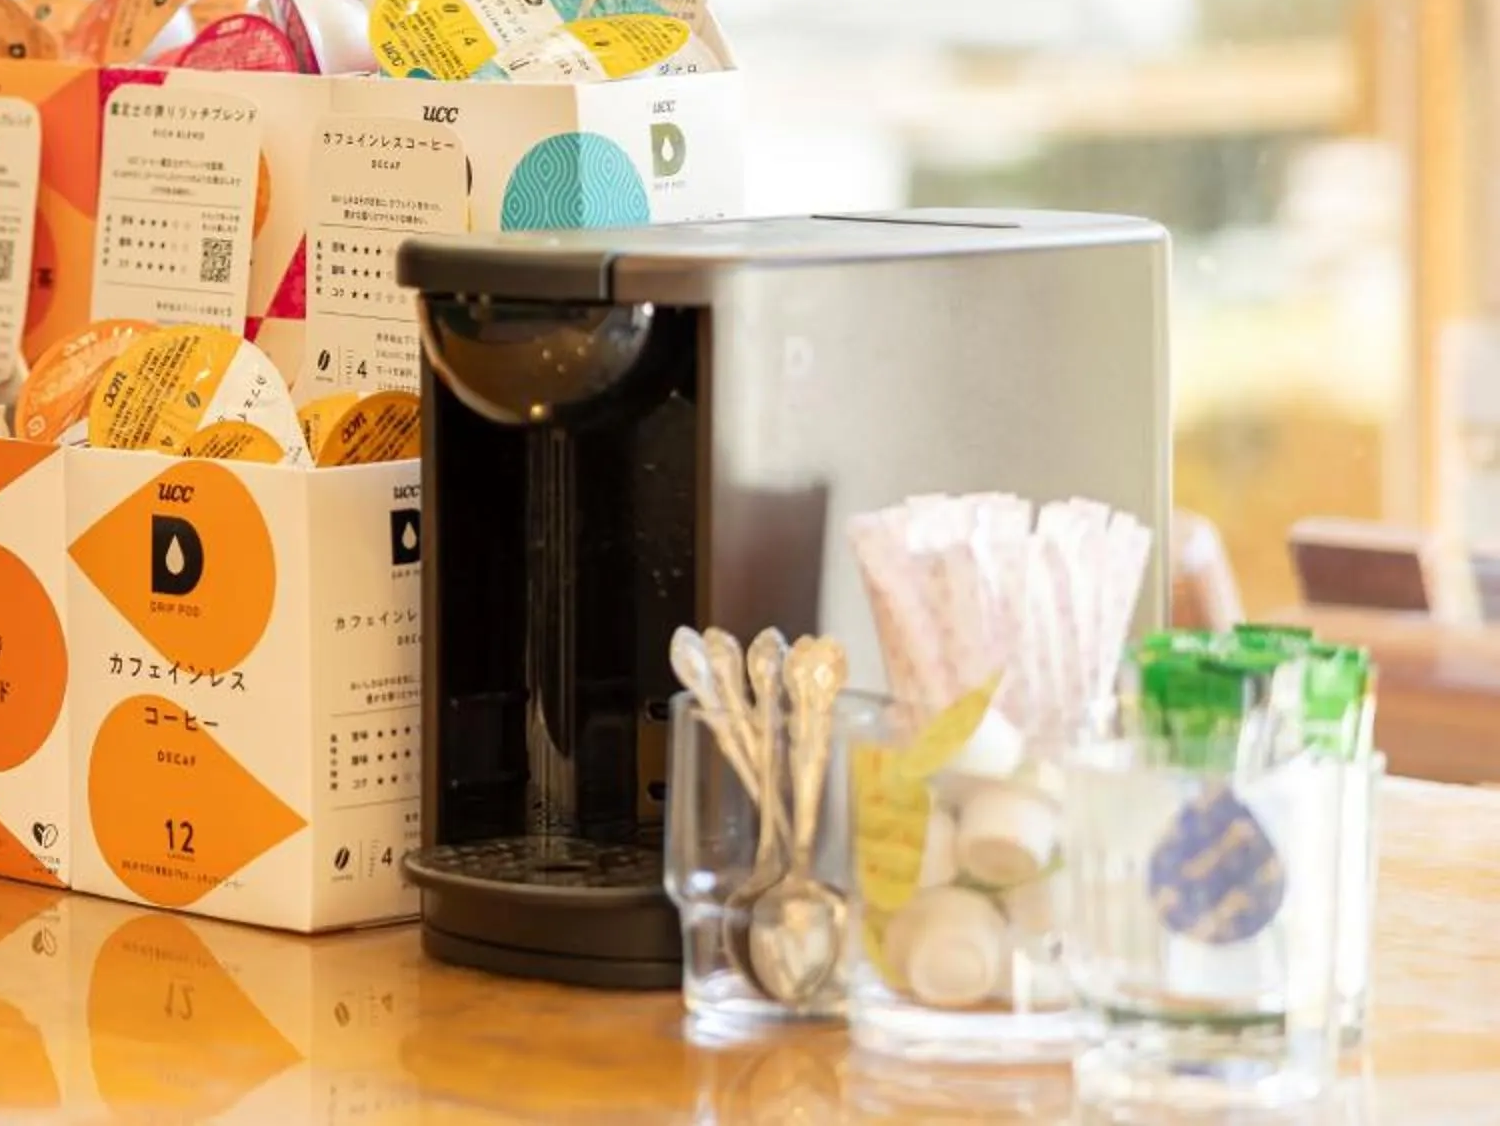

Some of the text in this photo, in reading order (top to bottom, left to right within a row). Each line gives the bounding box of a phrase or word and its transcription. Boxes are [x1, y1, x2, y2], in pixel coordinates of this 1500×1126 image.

[423, 105, 459, 124] UCC
[323, 131, 455, 151] カフェインレスコーヒー
[357, 359, 368, 378] 4
[103, 370, 128, 408] UCC
[158, 482, 195, 503] UCC
[393, 485, 421, 499] UCC
[151, 514, 204, 597] D
[334, 608, 418, 632] カフェインレ
[109, 653, 245, 691] カフェインレス
[144, 706, 219, 732] コーヒー
[157, 749, 196, 767] DECAF
[165, 818, 196, 854] 12
[381, 846, 393, 866] 4
